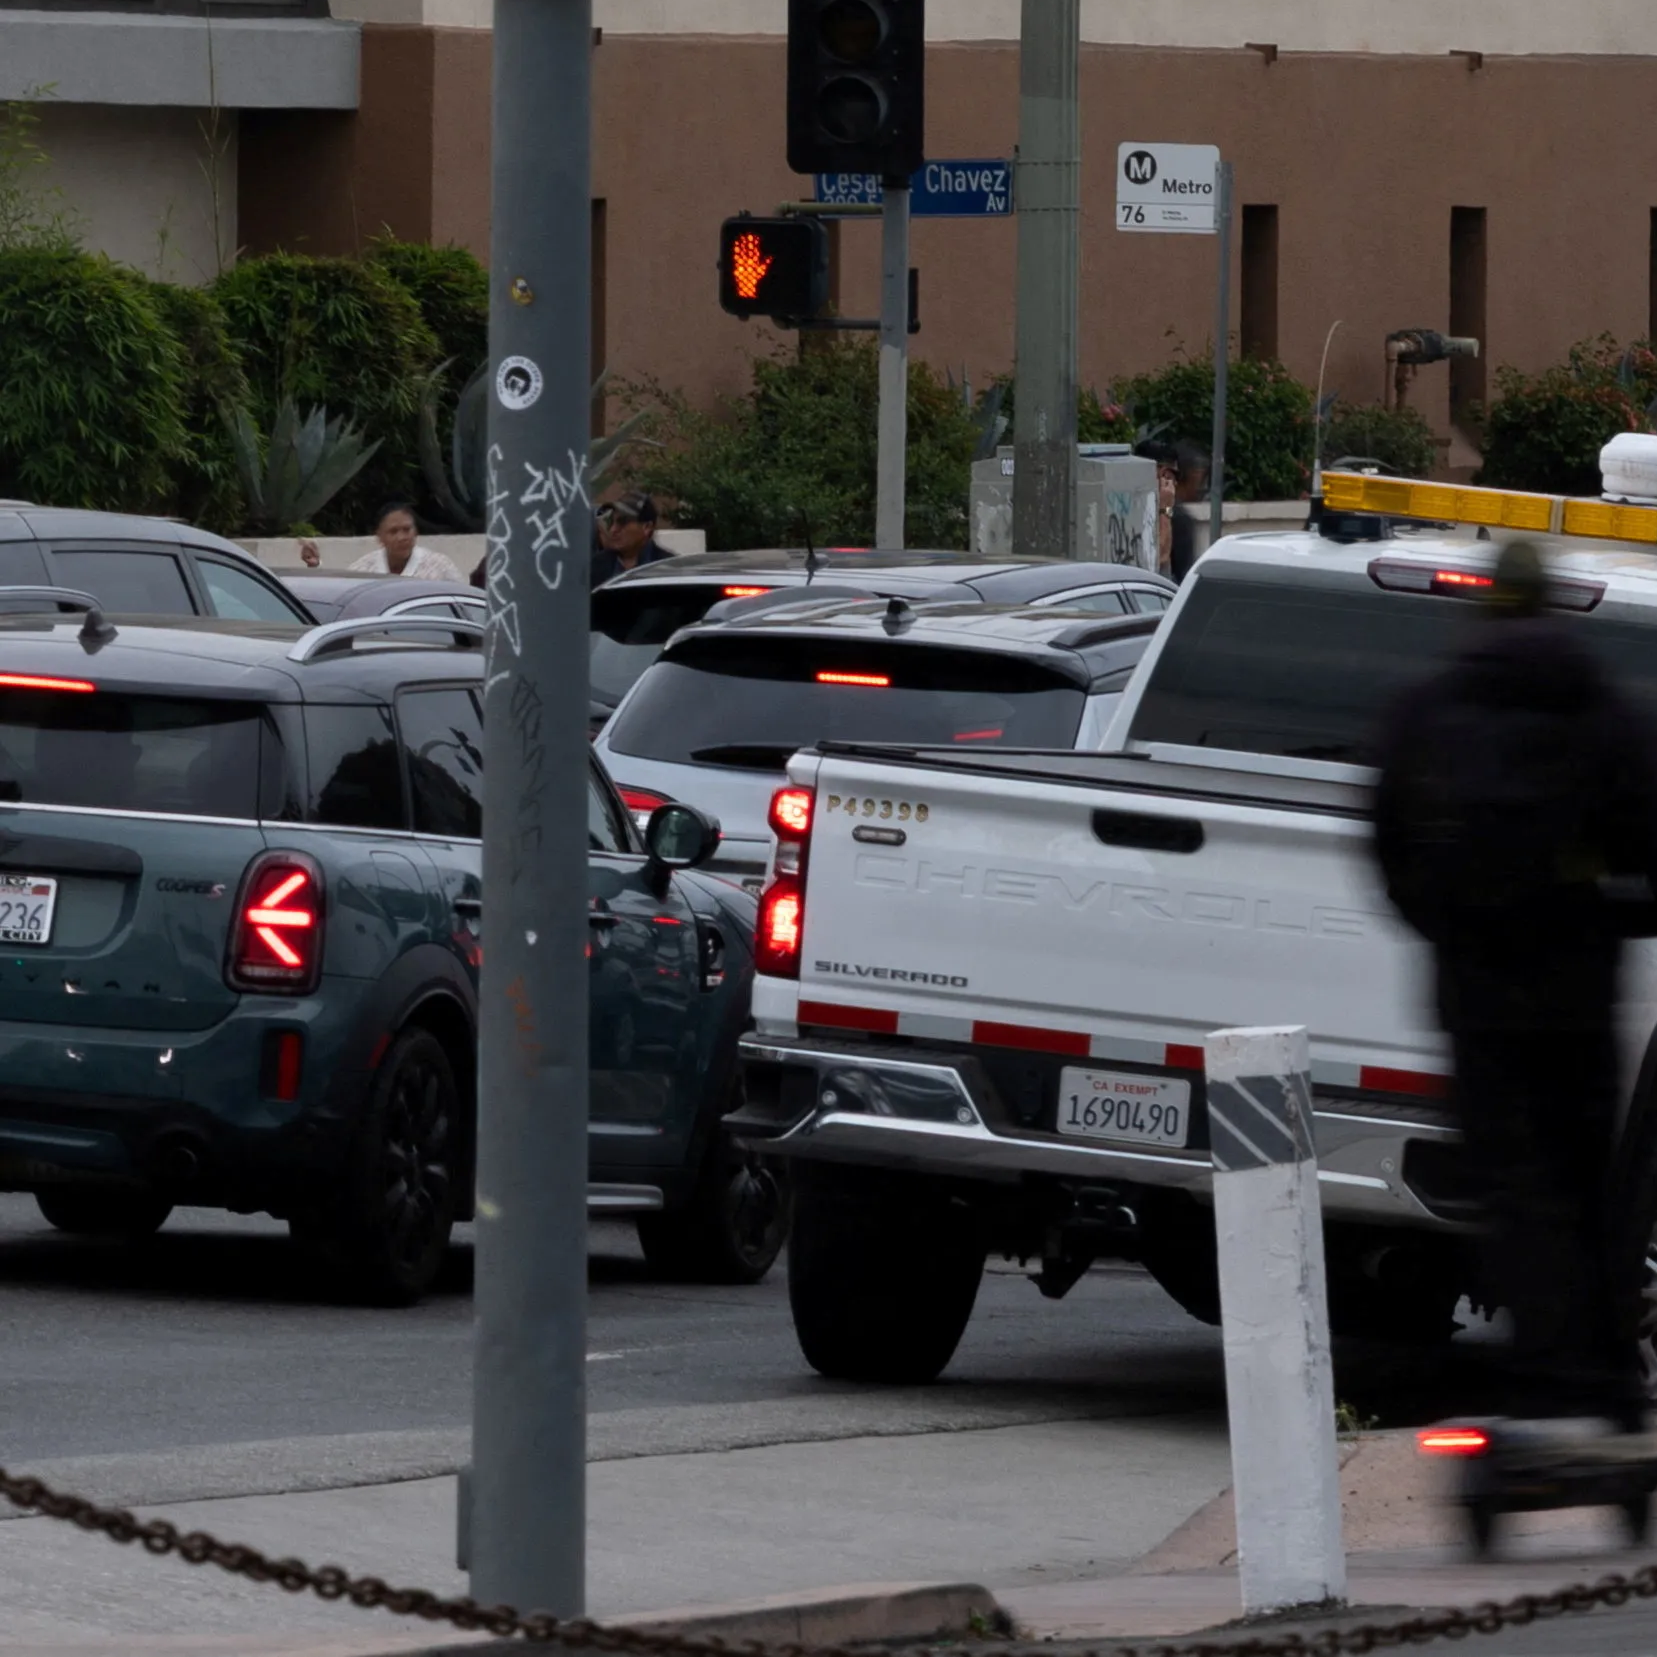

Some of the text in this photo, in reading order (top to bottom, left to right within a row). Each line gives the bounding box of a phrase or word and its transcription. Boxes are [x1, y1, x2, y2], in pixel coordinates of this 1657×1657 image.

[925, 164, 1006, 193] Chavez
[1162, 178, 1212, 194] Metro
[985, 194, 1006, 212] Av
[1121, 205, 1145, 224] 76
[826, 793, 930, 824] P49398
[852, 851, 1368, 941] CHEVROLE
[813, 958, 969, 989] SILVERADO
[1092, 1079, 1159, 1098] CA EXEMPT
[1066, 1093, 1180, 1139] 1690490
